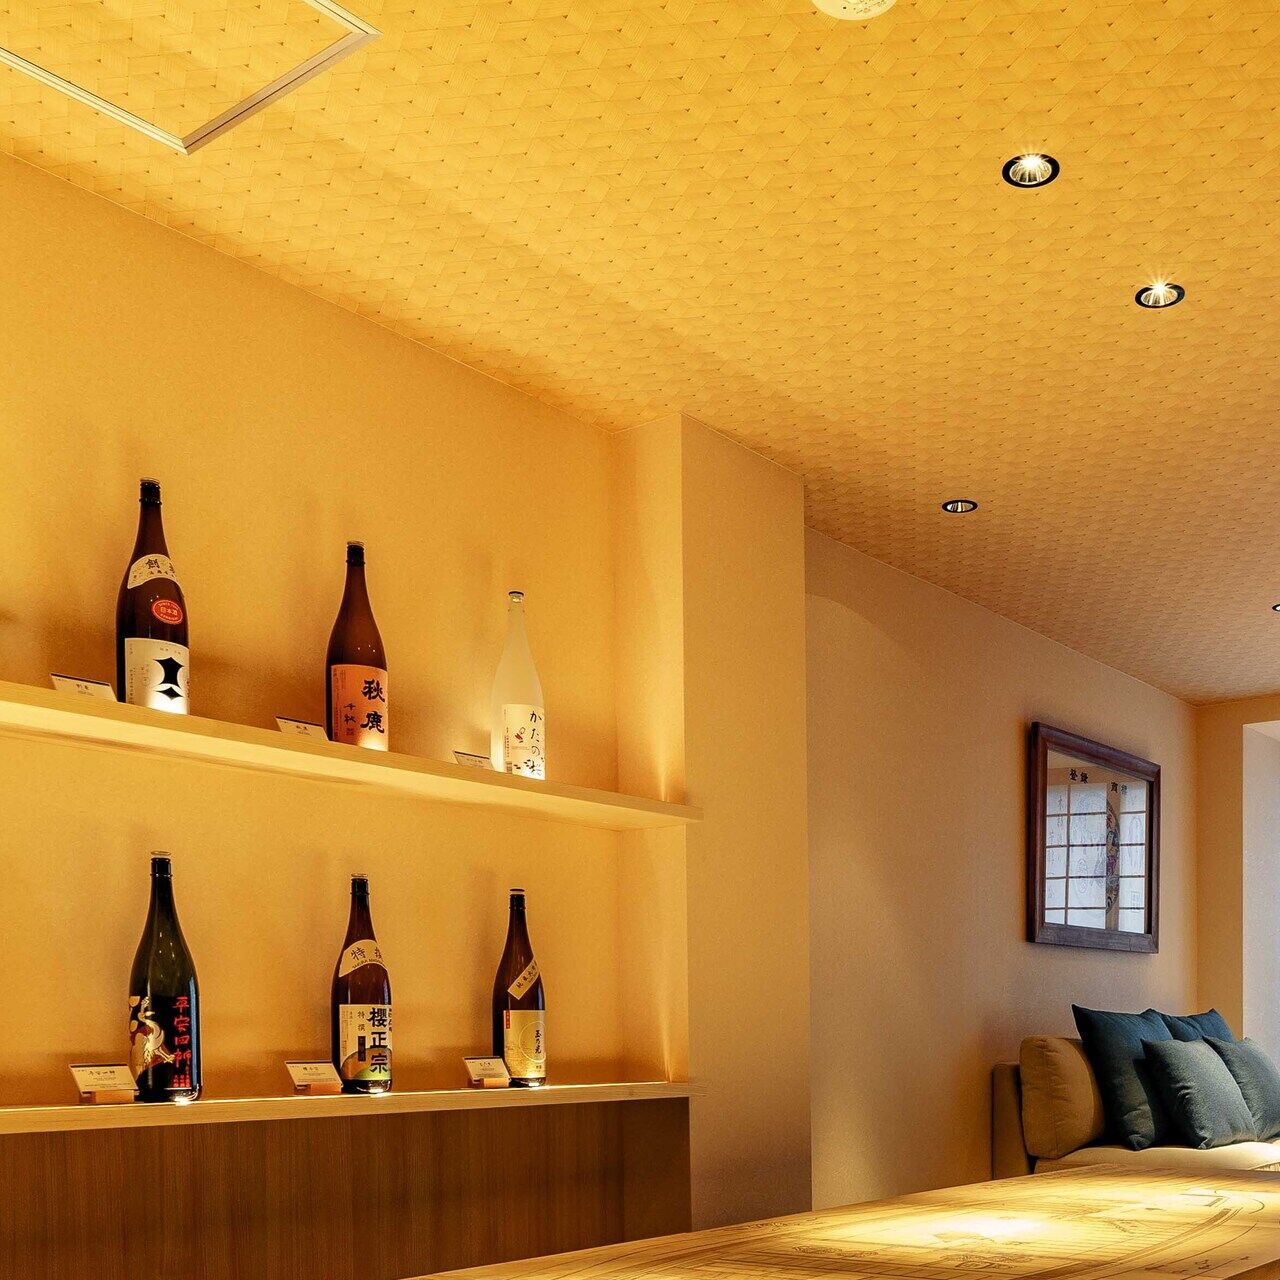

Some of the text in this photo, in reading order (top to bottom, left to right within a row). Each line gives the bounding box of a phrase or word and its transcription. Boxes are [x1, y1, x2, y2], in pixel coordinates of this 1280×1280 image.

[360, 679, 385, 733] 秋鹿
[367, 1007, 388, 1073] 櫻正宗
